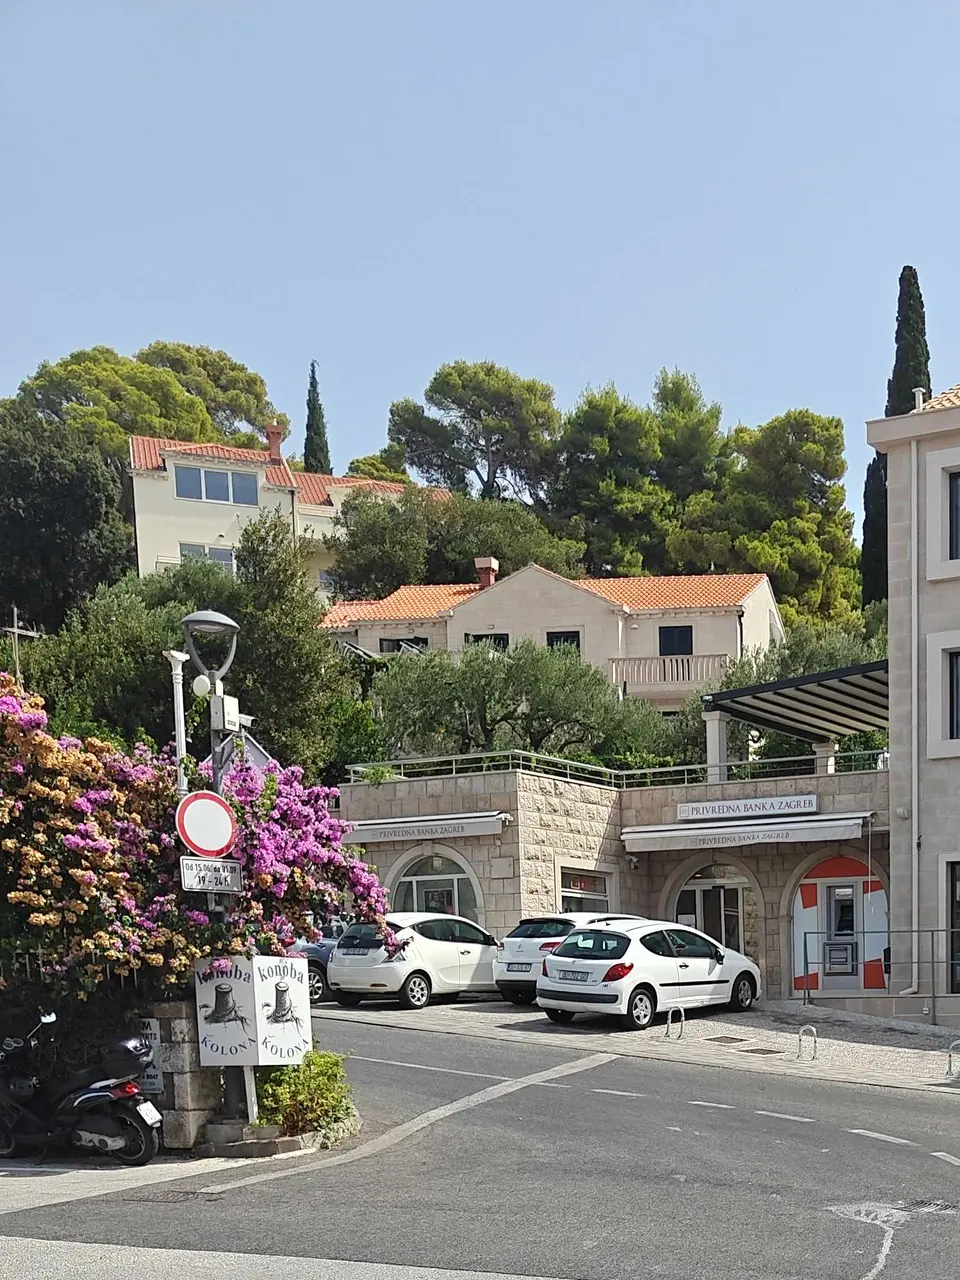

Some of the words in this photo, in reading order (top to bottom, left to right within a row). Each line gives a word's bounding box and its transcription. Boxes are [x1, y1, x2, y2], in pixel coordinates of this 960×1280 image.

[691, 804, 741, 816] PRIVREDNA
[743, 802, 776, 813] BANKA
[777, 799, 814, 811] ZAGREB
[379, 829, 416, 839] PRIVREDNA
[417, 827, 440, 836] BANKA
[439, 825, 466, 835] ZAGREB
[698, 836, 737, 846] PRIVREDNA
[738, 834, 761, 843] BANKA
[761, 831, 790, 840] ZAGREB
[185, 863, 194, 871] Od
[198, 875, 206, 886] 19
[214, 876, 223, 886] 24
[257, 962, 305, 984] konoba
[201, 1035, 257, 1056] KOLONA
[261, 1035, 309, 1059] KOLONA
